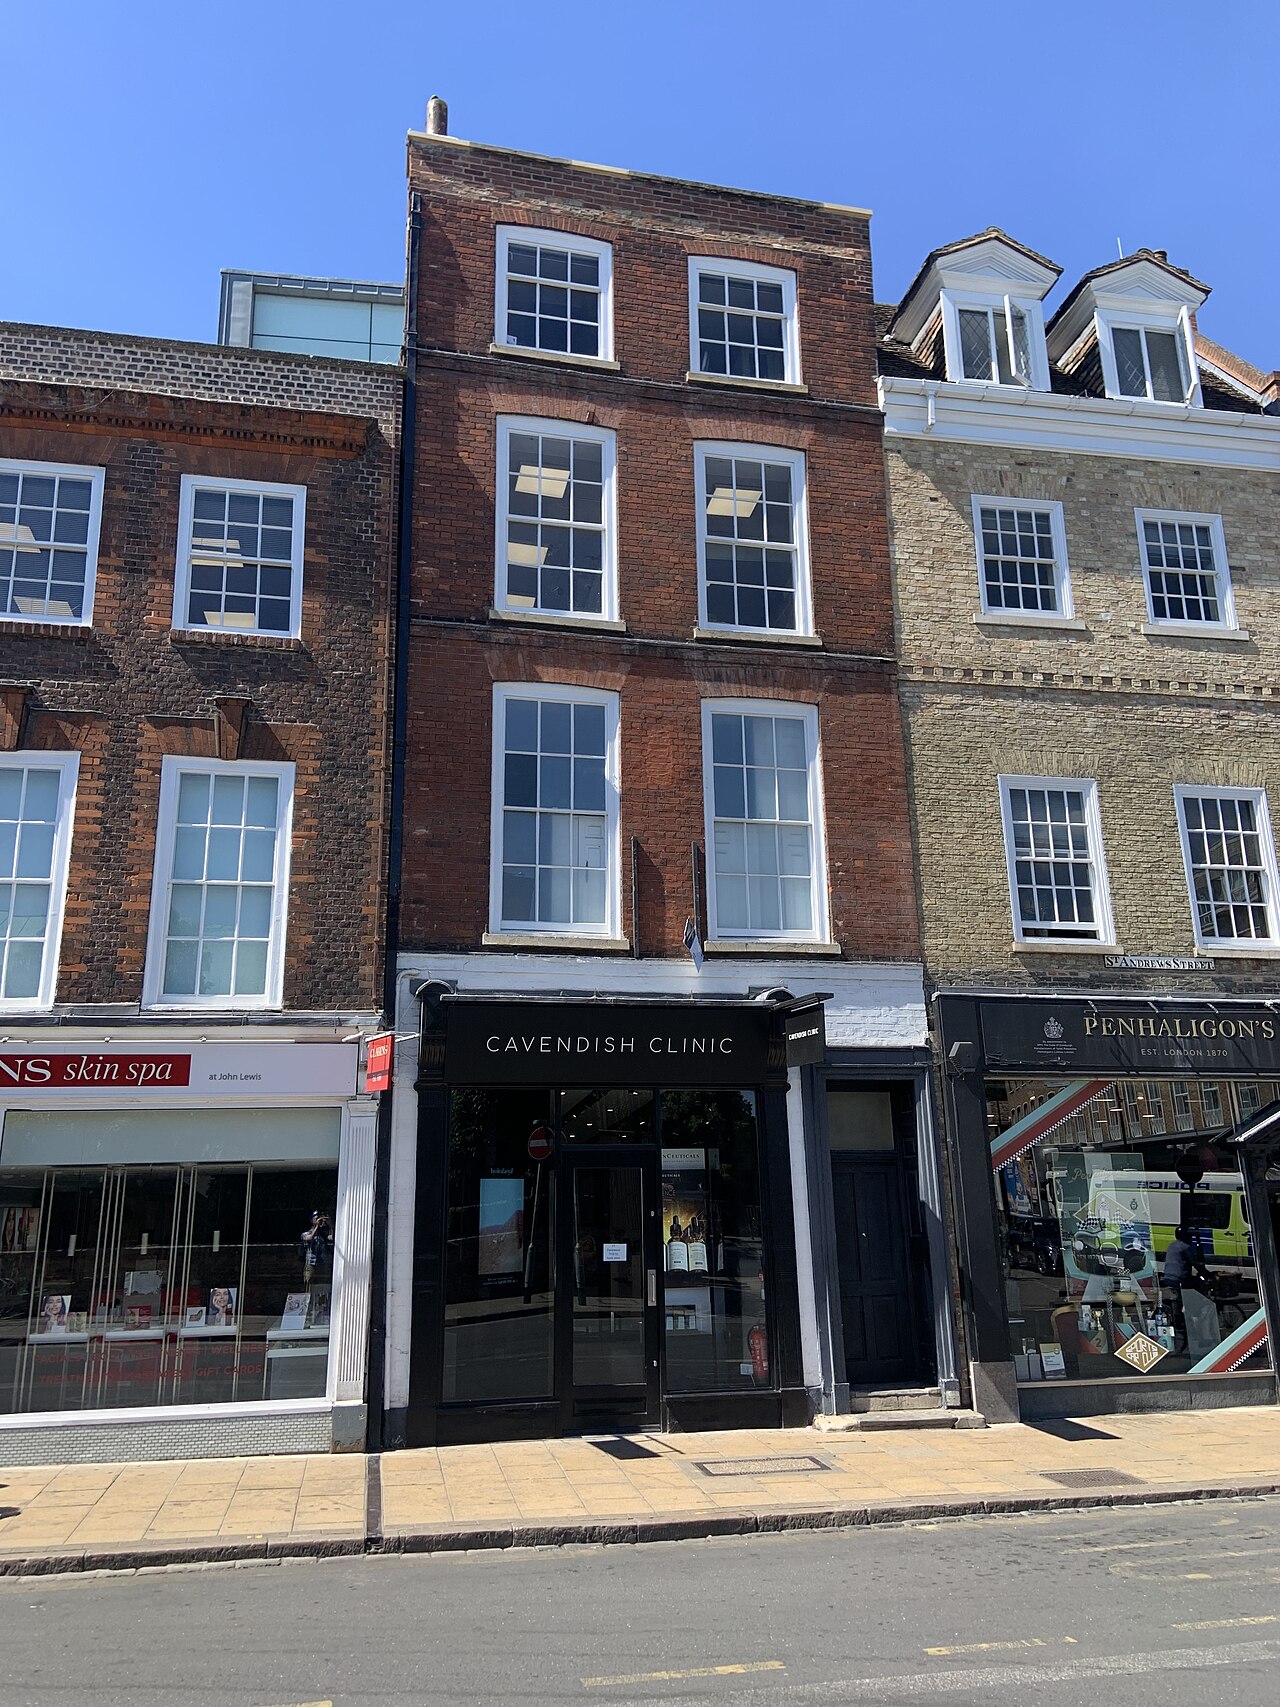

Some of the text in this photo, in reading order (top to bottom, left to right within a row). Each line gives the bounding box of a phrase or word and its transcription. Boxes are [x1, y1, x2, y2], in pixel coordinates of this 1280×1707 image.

[1083, 1017, 1275, 1039] PENHALIGON'S
[486, 1036, 733, 1054] CAVENDISH CLINIC
[1141, 1048, 1228, 1057] EST. LONDON 1870
[63, 1055, 120, 1081] skin
[125, 1062, 173, 1086] spa
[208, 1072, 262, 1081] at John Lewis
[1095, 1338, 1102, 1348] 2
[195, 1366, 221, 1377] GIFT
[223, 1364, 262, 1375] CARDS
